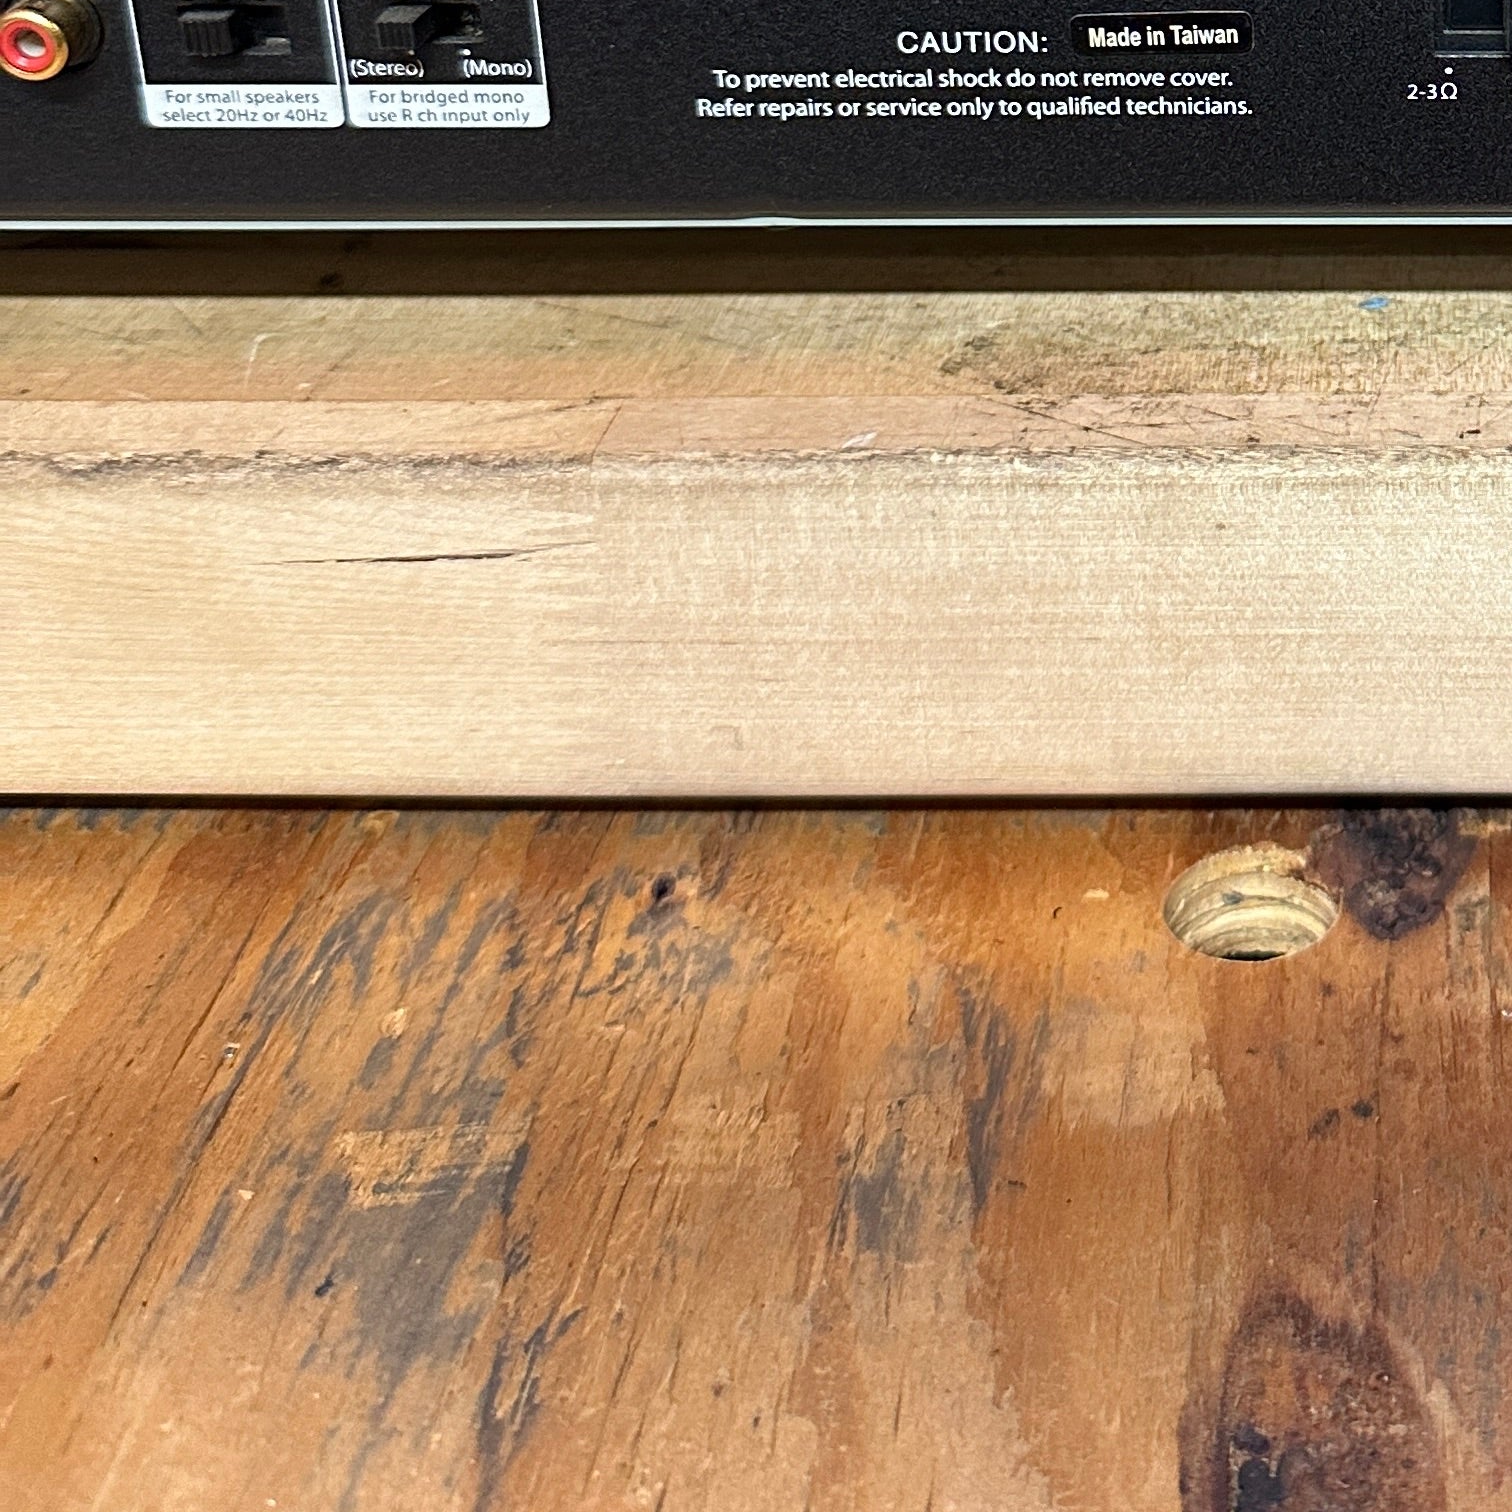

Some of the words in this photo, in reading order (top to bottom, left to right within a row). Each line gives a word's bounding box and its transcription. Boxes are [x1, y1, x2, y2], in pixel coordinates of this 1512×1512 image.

[896, 30, 1048, 54] CAUTION:
[1088, 26, 1142, 48] Made
[1146, 25, 1166, 46] in
[1168, 24, 1239, 46] Taiwan
[349, 58, 425, 79] (Stereo)
[462, 58, 533, 79] (Mono)
[711, 69, 741, 89] To
[744, 71, 831, 93] prevent
[834, 68, 933, 89] electrical
[938, 67, 1003, 88] shock
[1005, 67, 1036, 88] do
[1040, 70, 1079, 88] not
[1083, 72, 1166, 87] remove
[1169, 71, 1233, 87] cover.
[165, 89, 193, 104] For
[196, 90, 240, 104] small
[245, 90, 320, 106] speakers
[368, 89, 396, 104] For
[400, 89, 469, 108] bridged
[473, 92, 525, 104] mono
[162, 108, 212, 122] select
[216, 108, 258, 122] 20Hz
[262, 111, 281, 122] or
[284, 108, 328, 122] 40Hz
[368, 111, 398, 123] use
[402, 108, 413, 122] R
[417, 108, 438, 122] ch
[442, 110, 489, 124] input
[495, 108, 530, 124] only
[695, 97, 755, 118] Refer
[758, 98, 834, 122] repairs
[837, 102, 862, 117] or
[865, 97, 943, 117] service
[946, 96, 995, 121] only
[997, 99, 1023, 116] to
[1026, 95, 1121, 120] qualified
[1125, 95, 1253, 116] technicians.
